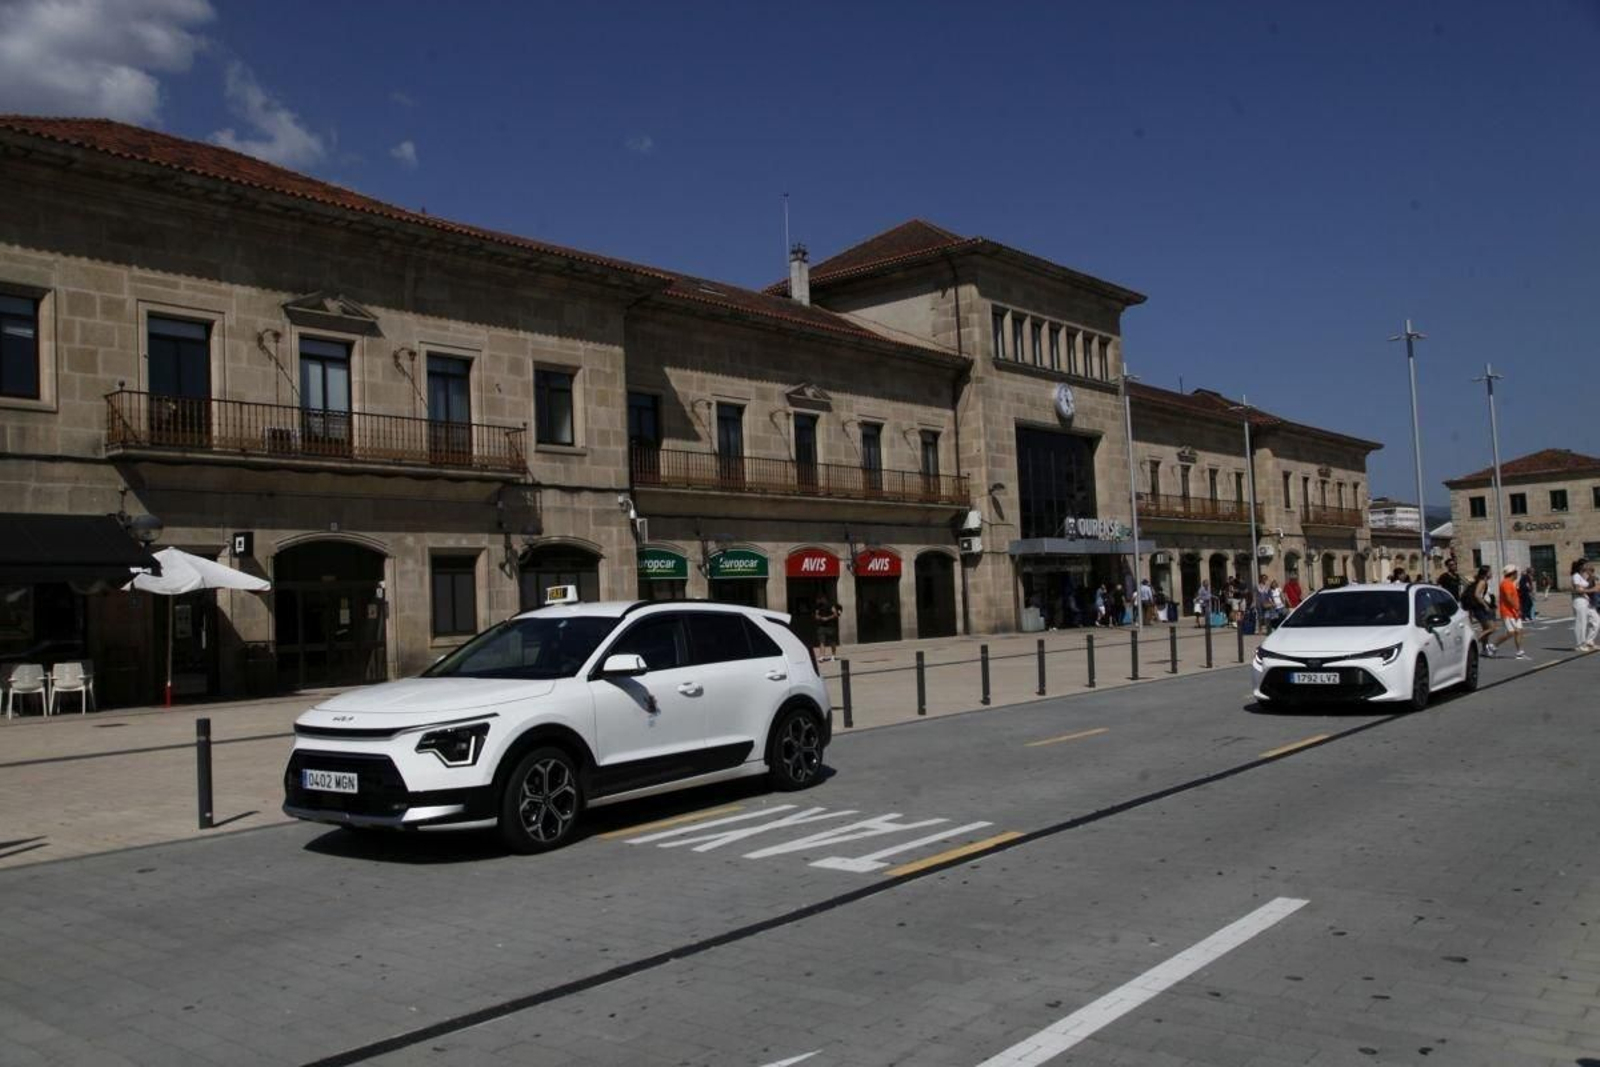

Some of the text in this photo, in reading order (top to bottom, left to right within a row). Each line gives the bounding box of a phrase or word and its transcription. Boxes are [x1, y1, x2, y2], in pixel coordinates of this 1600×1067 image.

[801, 558, 826, 571] AVIS
[868, 558, 890, 571] AVIS
[1297, 674, 1318, 682] 1792
[308, 773, 332, 788] 0402
